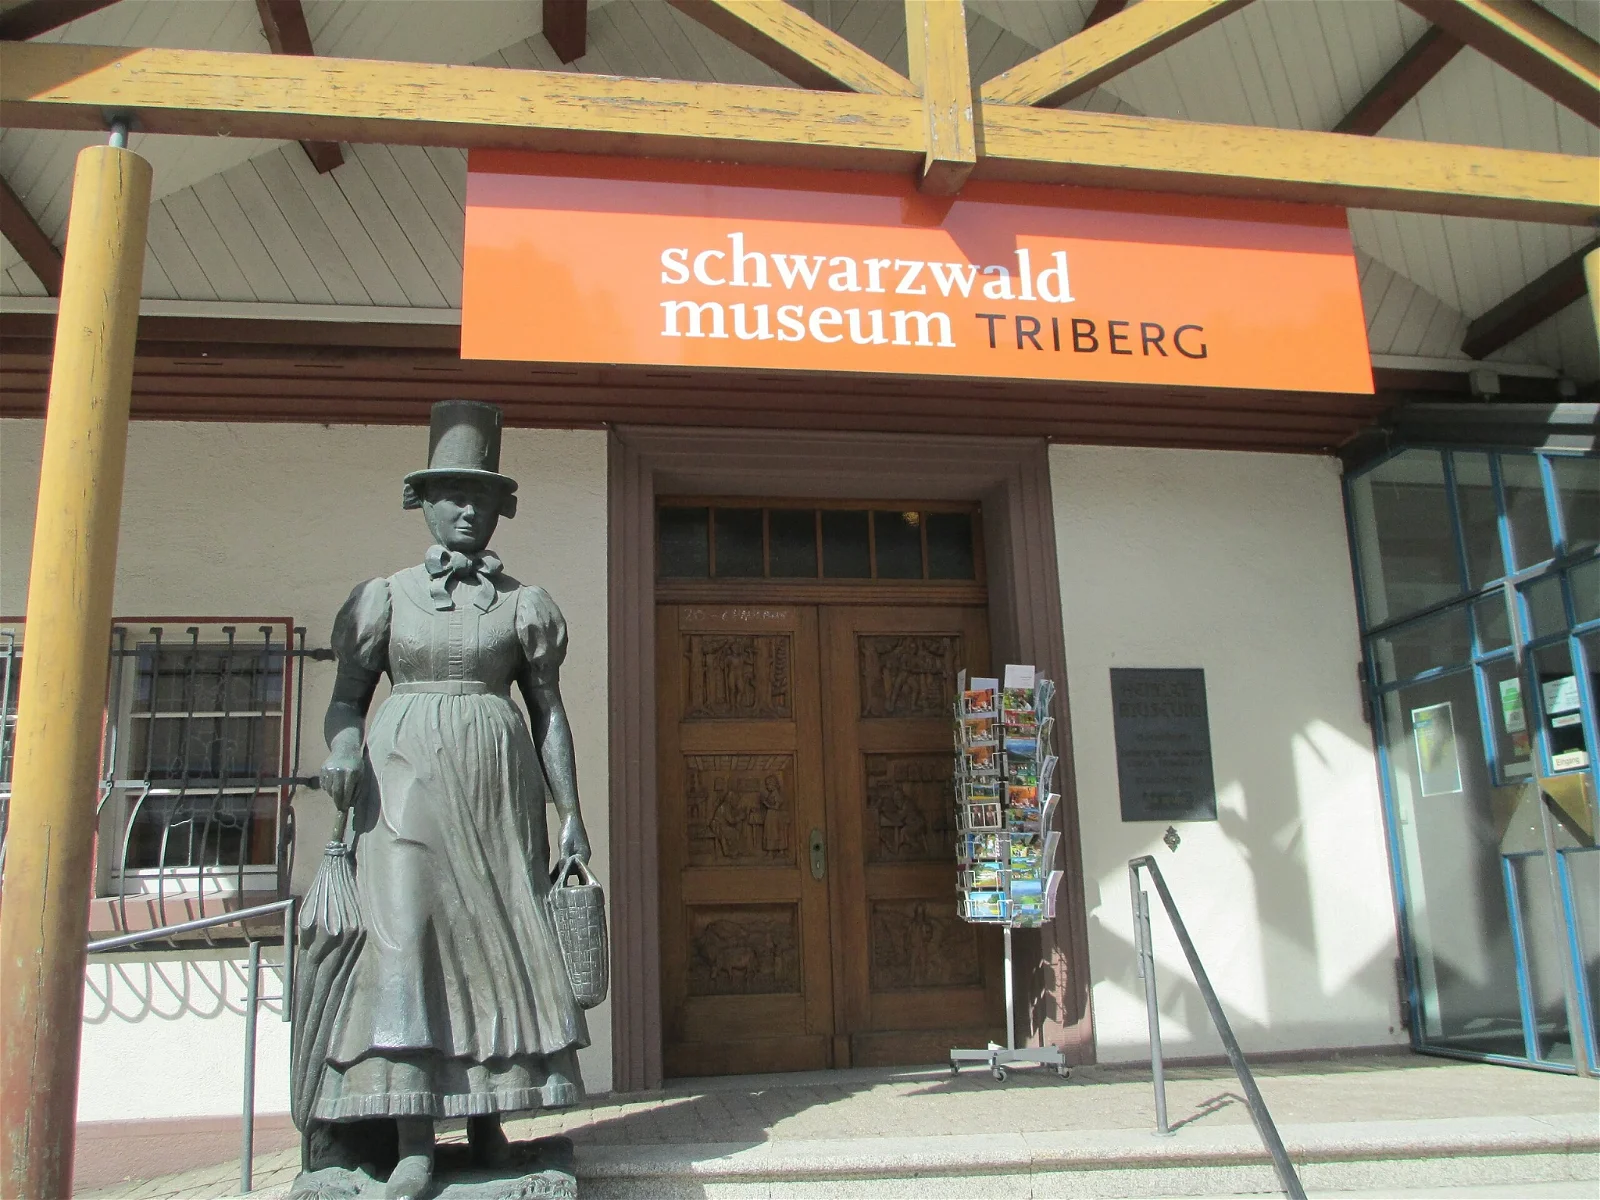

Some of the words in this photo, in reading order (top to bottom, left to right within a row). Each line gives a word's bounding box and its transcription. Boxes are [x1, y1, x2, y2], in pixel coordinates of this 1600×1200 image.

[660, 232, 1076, 303] schwarzwald
[659, 300, 956, 348] museum
[975, 313, 1208, 359] TRIBERG
